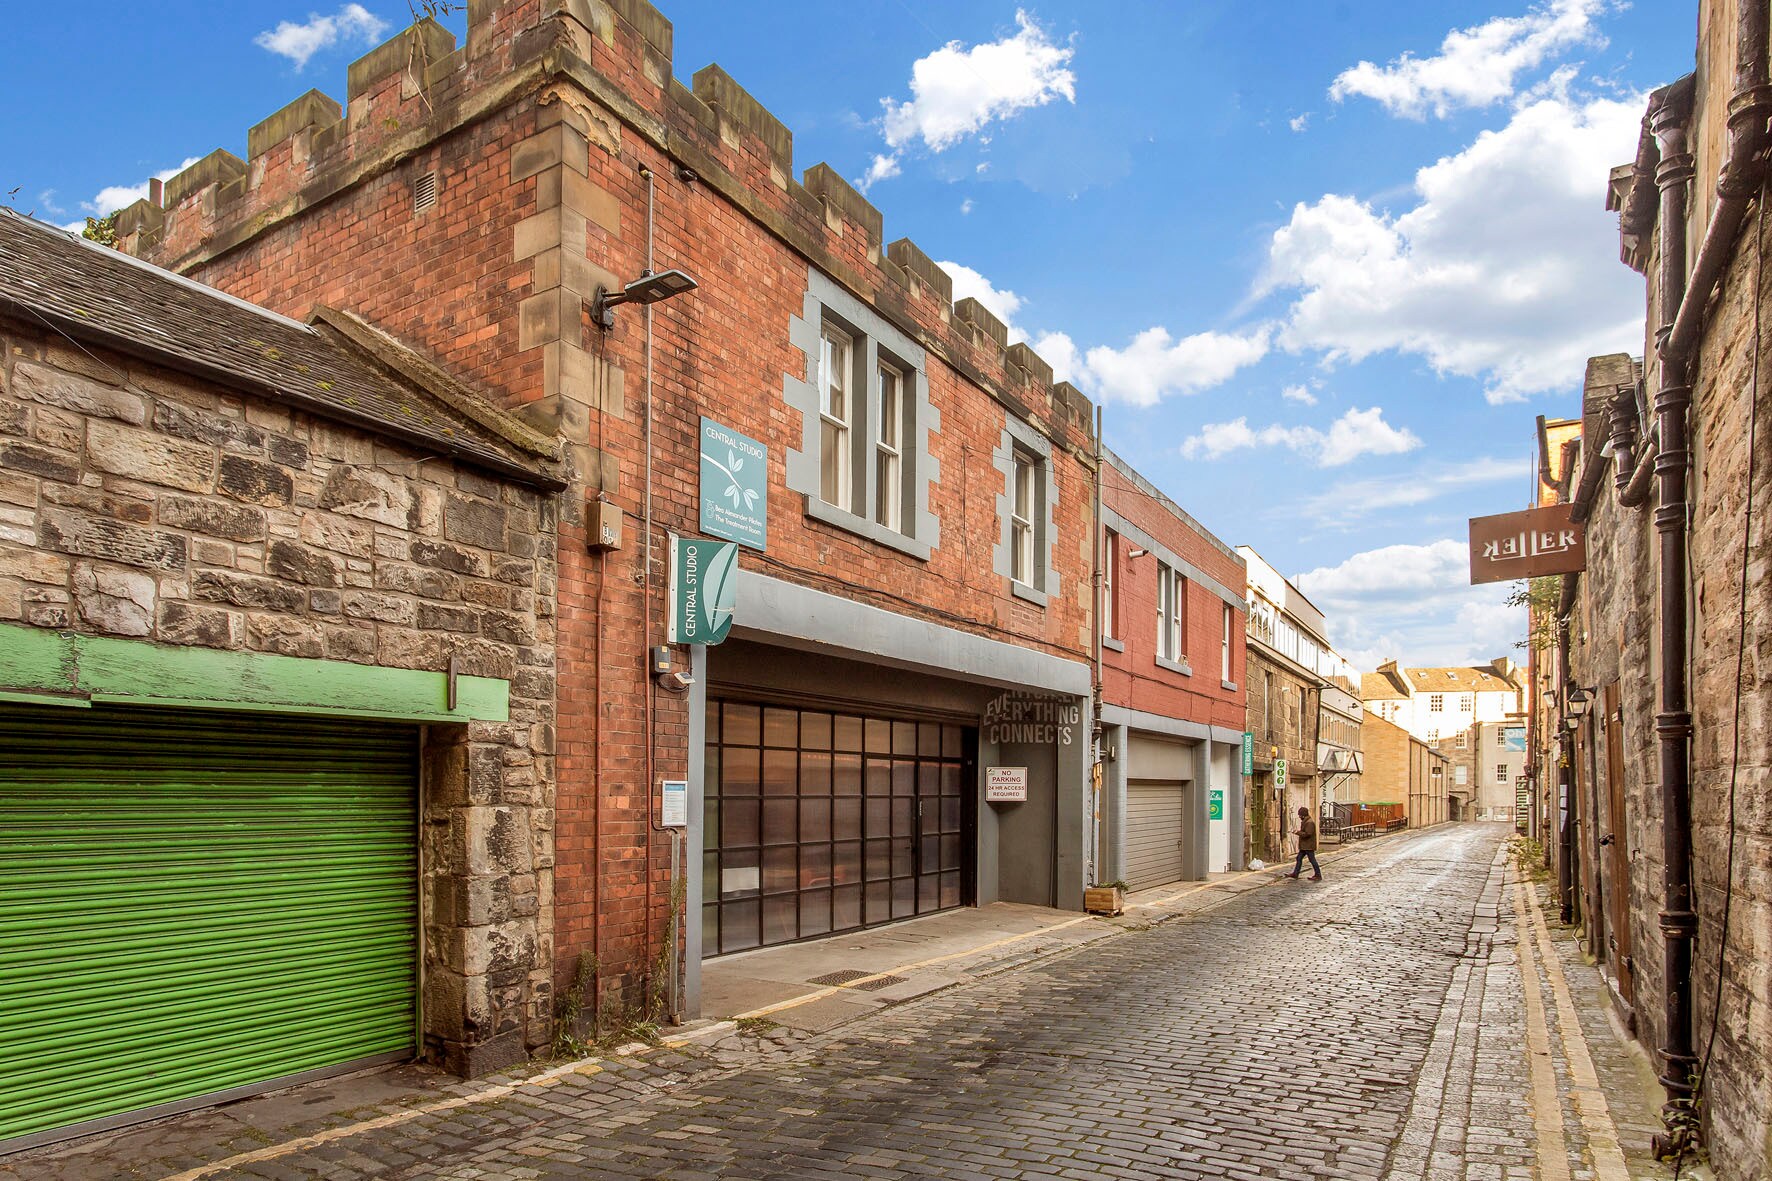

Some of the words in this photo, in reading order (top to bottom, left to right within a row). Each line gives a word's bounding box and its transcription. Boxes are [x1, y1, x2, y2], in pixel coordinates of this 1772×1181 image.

[705, 427, 738, 449] CENTRAL
[738, 441, 763, 460] STUDIO
[715, 514, 725, 523] The
[724, 517, 749, 531] Treatment
[748, 525, 762, 537] Room
[685, 545, 698, 587] STUDIO
[685, 590, 697, 637] CENTRAL
[990, 722, 1073, 745] CONNECTS
